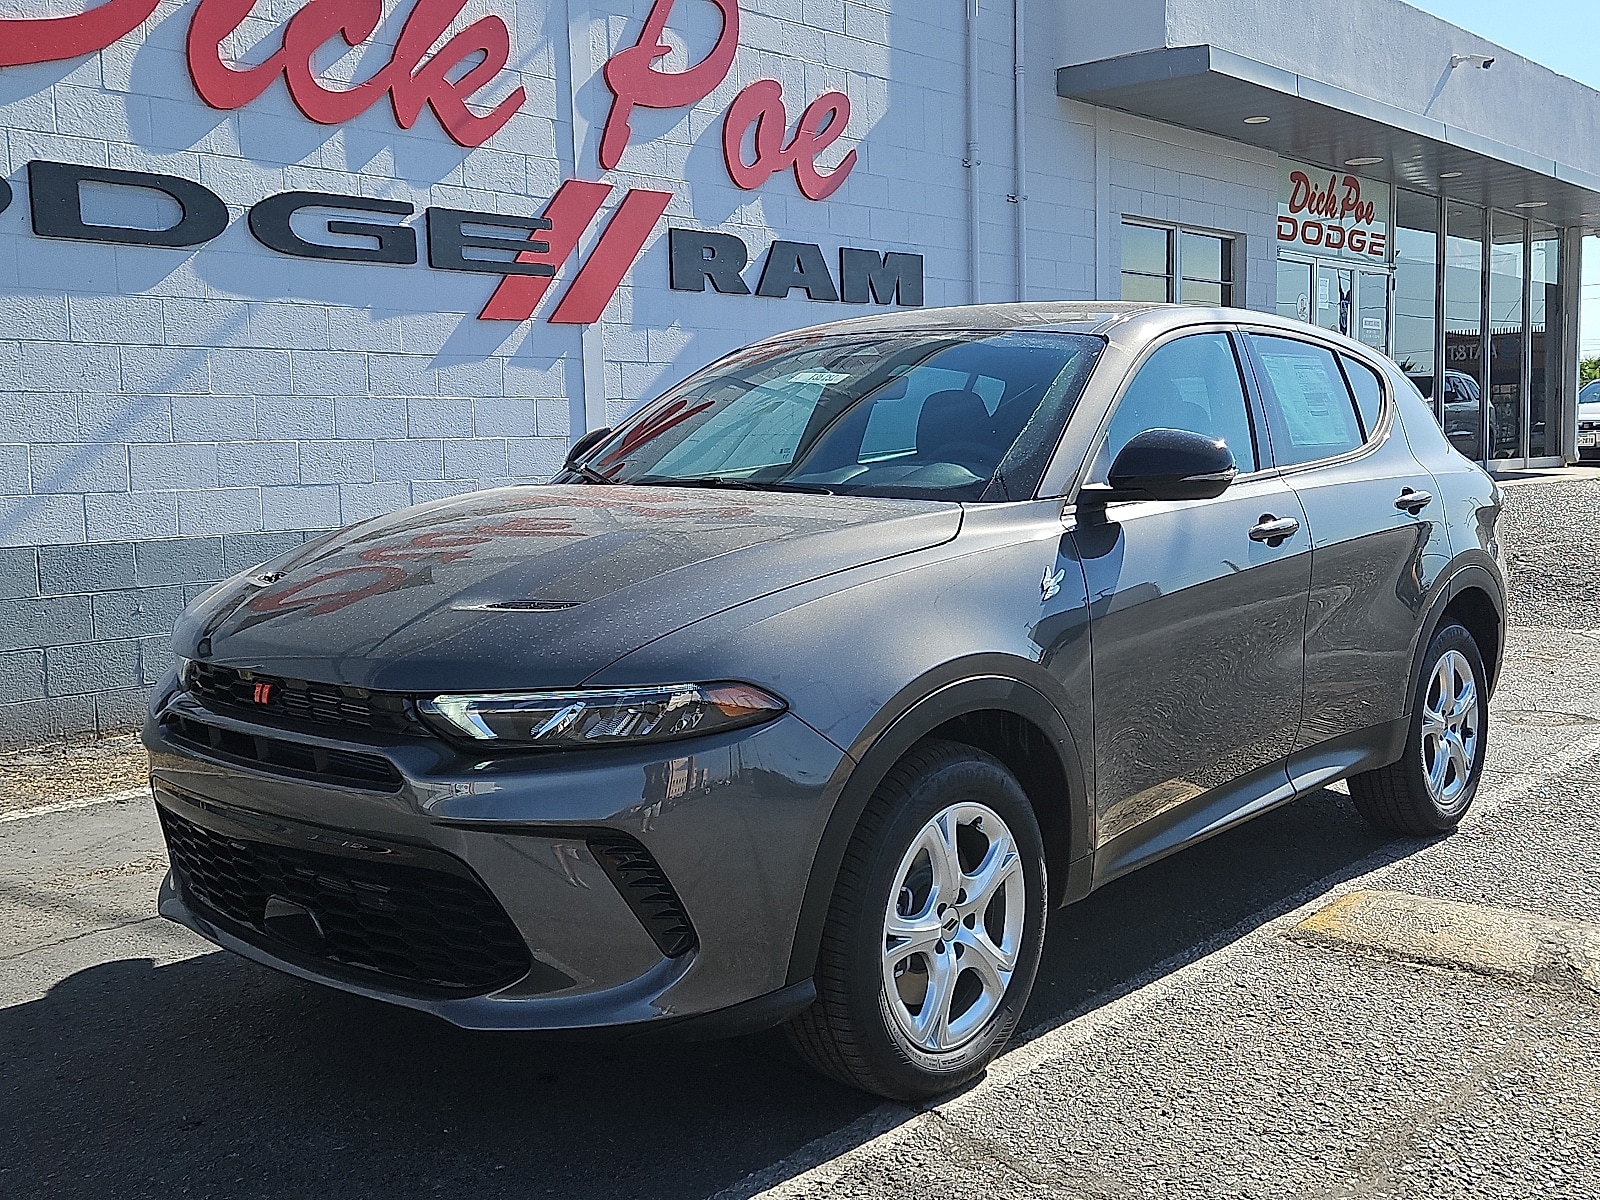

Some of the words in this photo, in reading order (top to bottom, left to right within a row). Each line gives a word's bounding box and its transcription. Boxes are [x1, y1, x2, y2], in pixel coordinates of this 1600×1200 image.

[599, 0, 857, 201] Poe
[0, 160, 555, 277] DGE
[669, 227, 923, 307] RAM
[1276, 215, 1386, 256] DODGE
[1288, 170, 1338, 219] Dick
[1340, 175, 1375, 225] Poe
